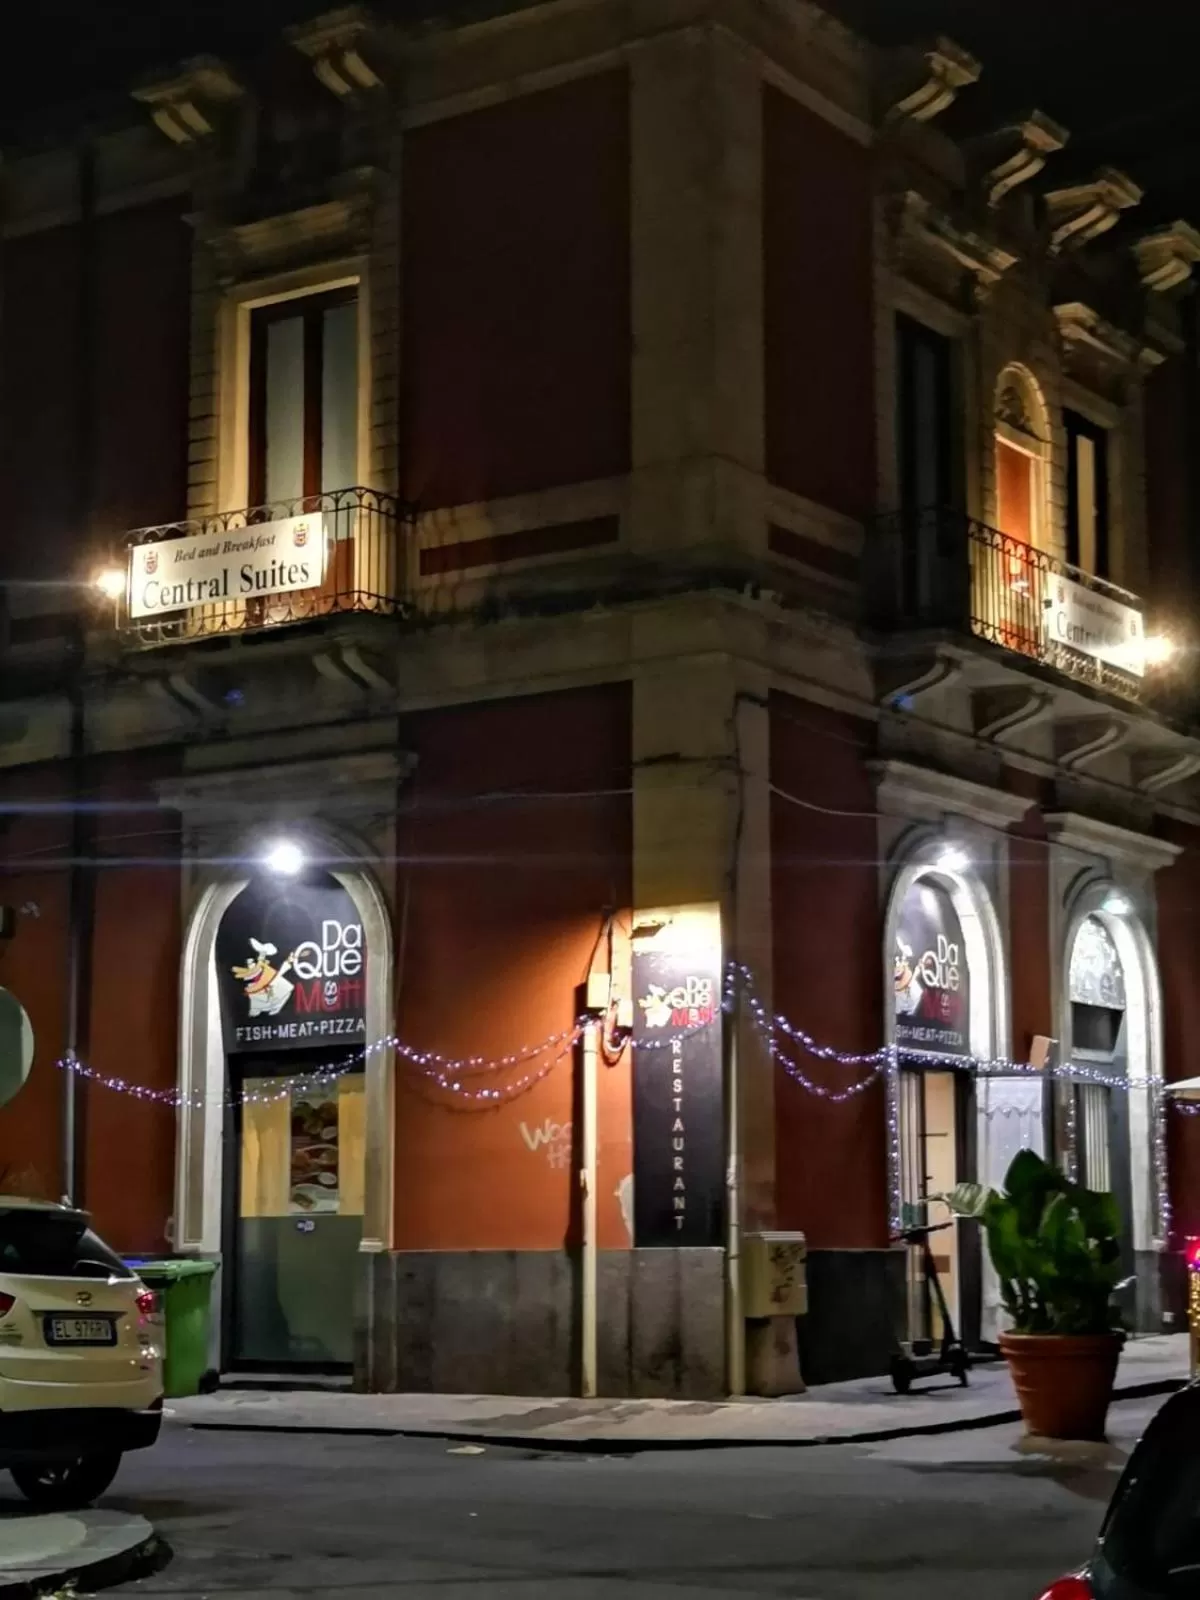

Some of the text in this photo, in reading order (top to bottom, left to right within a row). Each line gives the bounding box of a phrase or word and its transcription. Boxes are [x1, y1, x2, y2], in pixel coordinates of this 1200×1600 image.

[173, 534, 276, 564] Bed and Breakfast
[142, 559, 310, 609] Central Suites
[322, 919, 361, 951] Da
[937, 933, 959, 965] Da
[293, 941, 362, 980] Que
[921, 950, 960, 992] Que
[671, 987, 712, 1009] Que
[686, 975, 712, 993] Da
[671, 1038, 685, 1231] RESTAURANT
